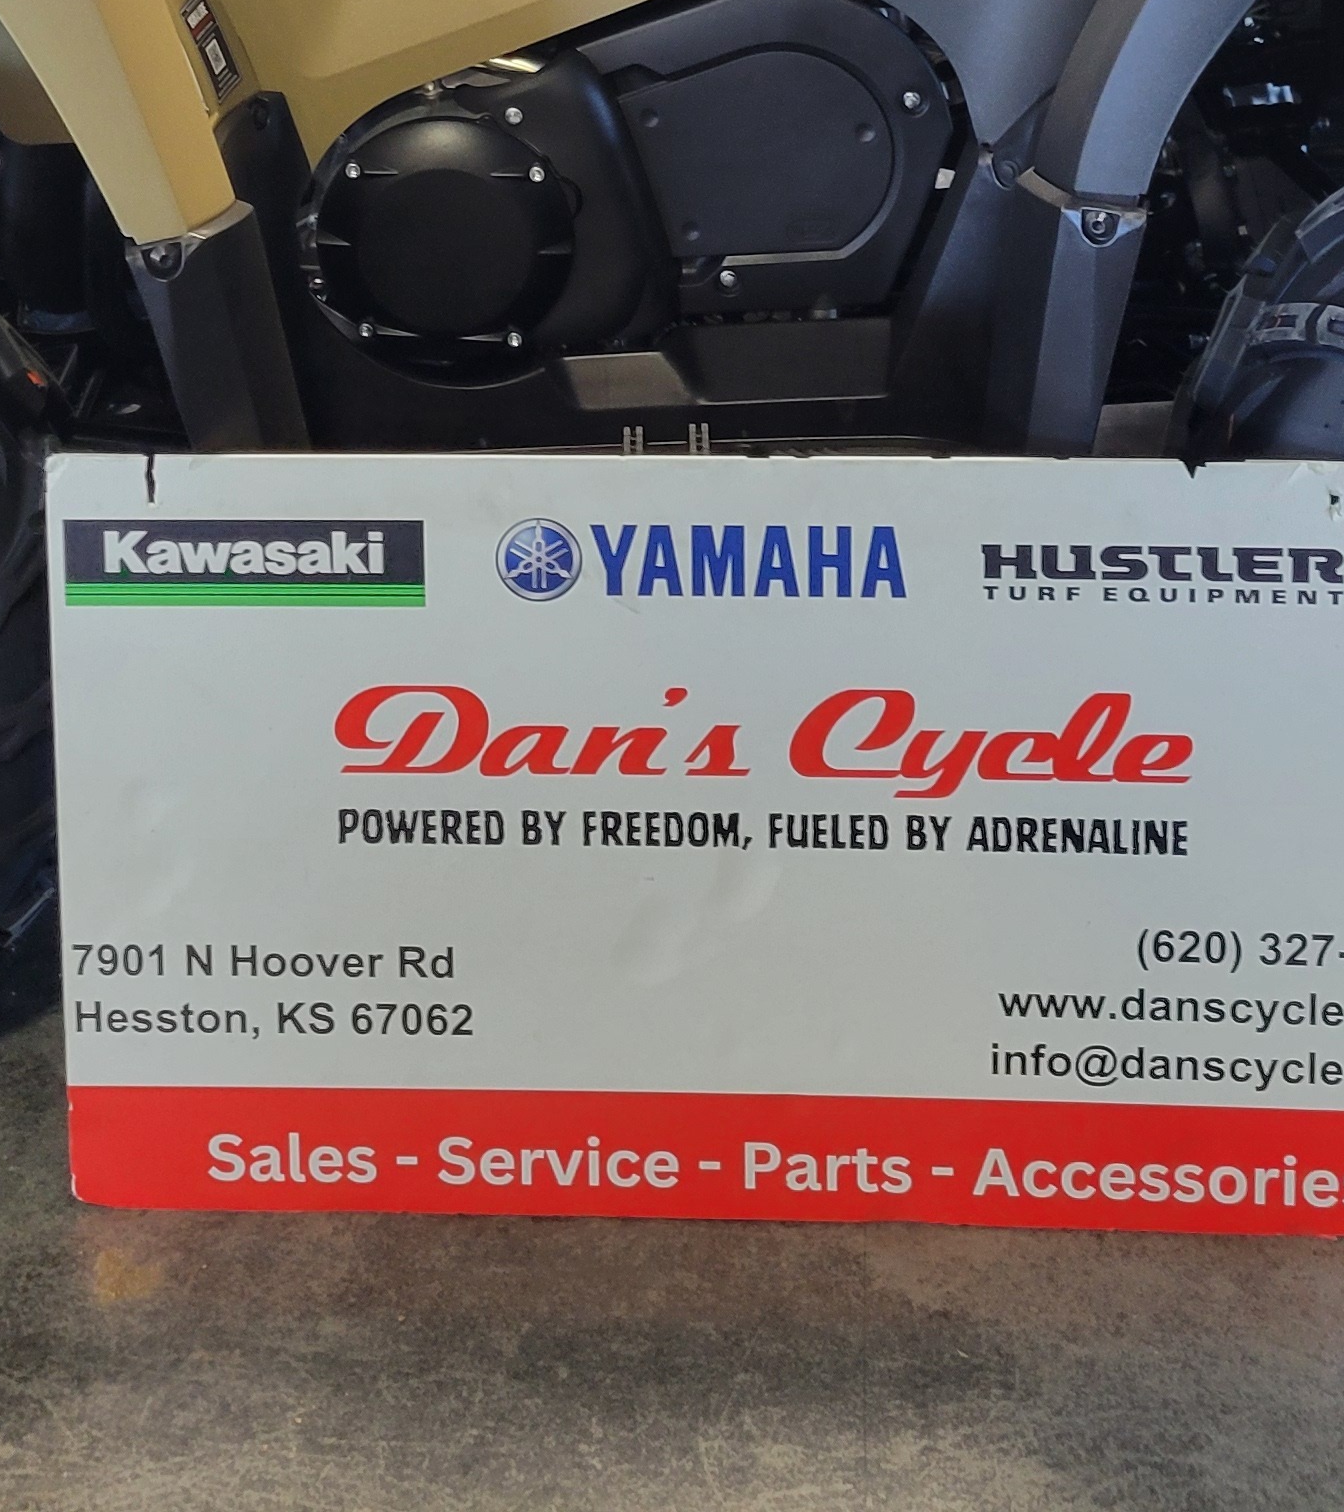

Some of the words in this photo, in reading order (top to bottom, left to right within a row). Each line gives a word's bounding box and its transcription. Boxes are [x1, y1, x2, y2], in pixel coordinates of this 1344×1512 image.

[102, 530, 385, 575] Kawasaki
[590, 525, 907, 599] YAMAHA
[981, 544, 1344, 584] HUSTLER
[982, 585, 1080, 602] TURF
[1103, 586, 1344, 605] EQUIPMENT
[333, 685, 750, 778] Dan's
[789, 689, 1194, 799] Cycle
[339, 809, 504, 845] POWERED
[522, 810, 566, 846] BY
[582, 811, 752, 852] FREEDOM,
[768, 813, 889, 850] FUELED
[906, 814, 951, 852] BY
[966, 816, 1190, 857] ADRENALINE
[71, 944, 165, 976] 7901
[186, 945, 213, 976] N
[231, 945, 384, 978] Hoover
[399, 946, 454, 979] Rd
[1137, 929, 1242, 974] (620)
[76, 1001, 261, 1039] Hesston,
[277, 1003, 335, 1035] KS
[352, 1004, 474, 1037] 67062
[207, 1133, 378, 1184] Sales
[437, 1136, 680, 1189] Service
[743, 1141, 913, 1194] Parts
